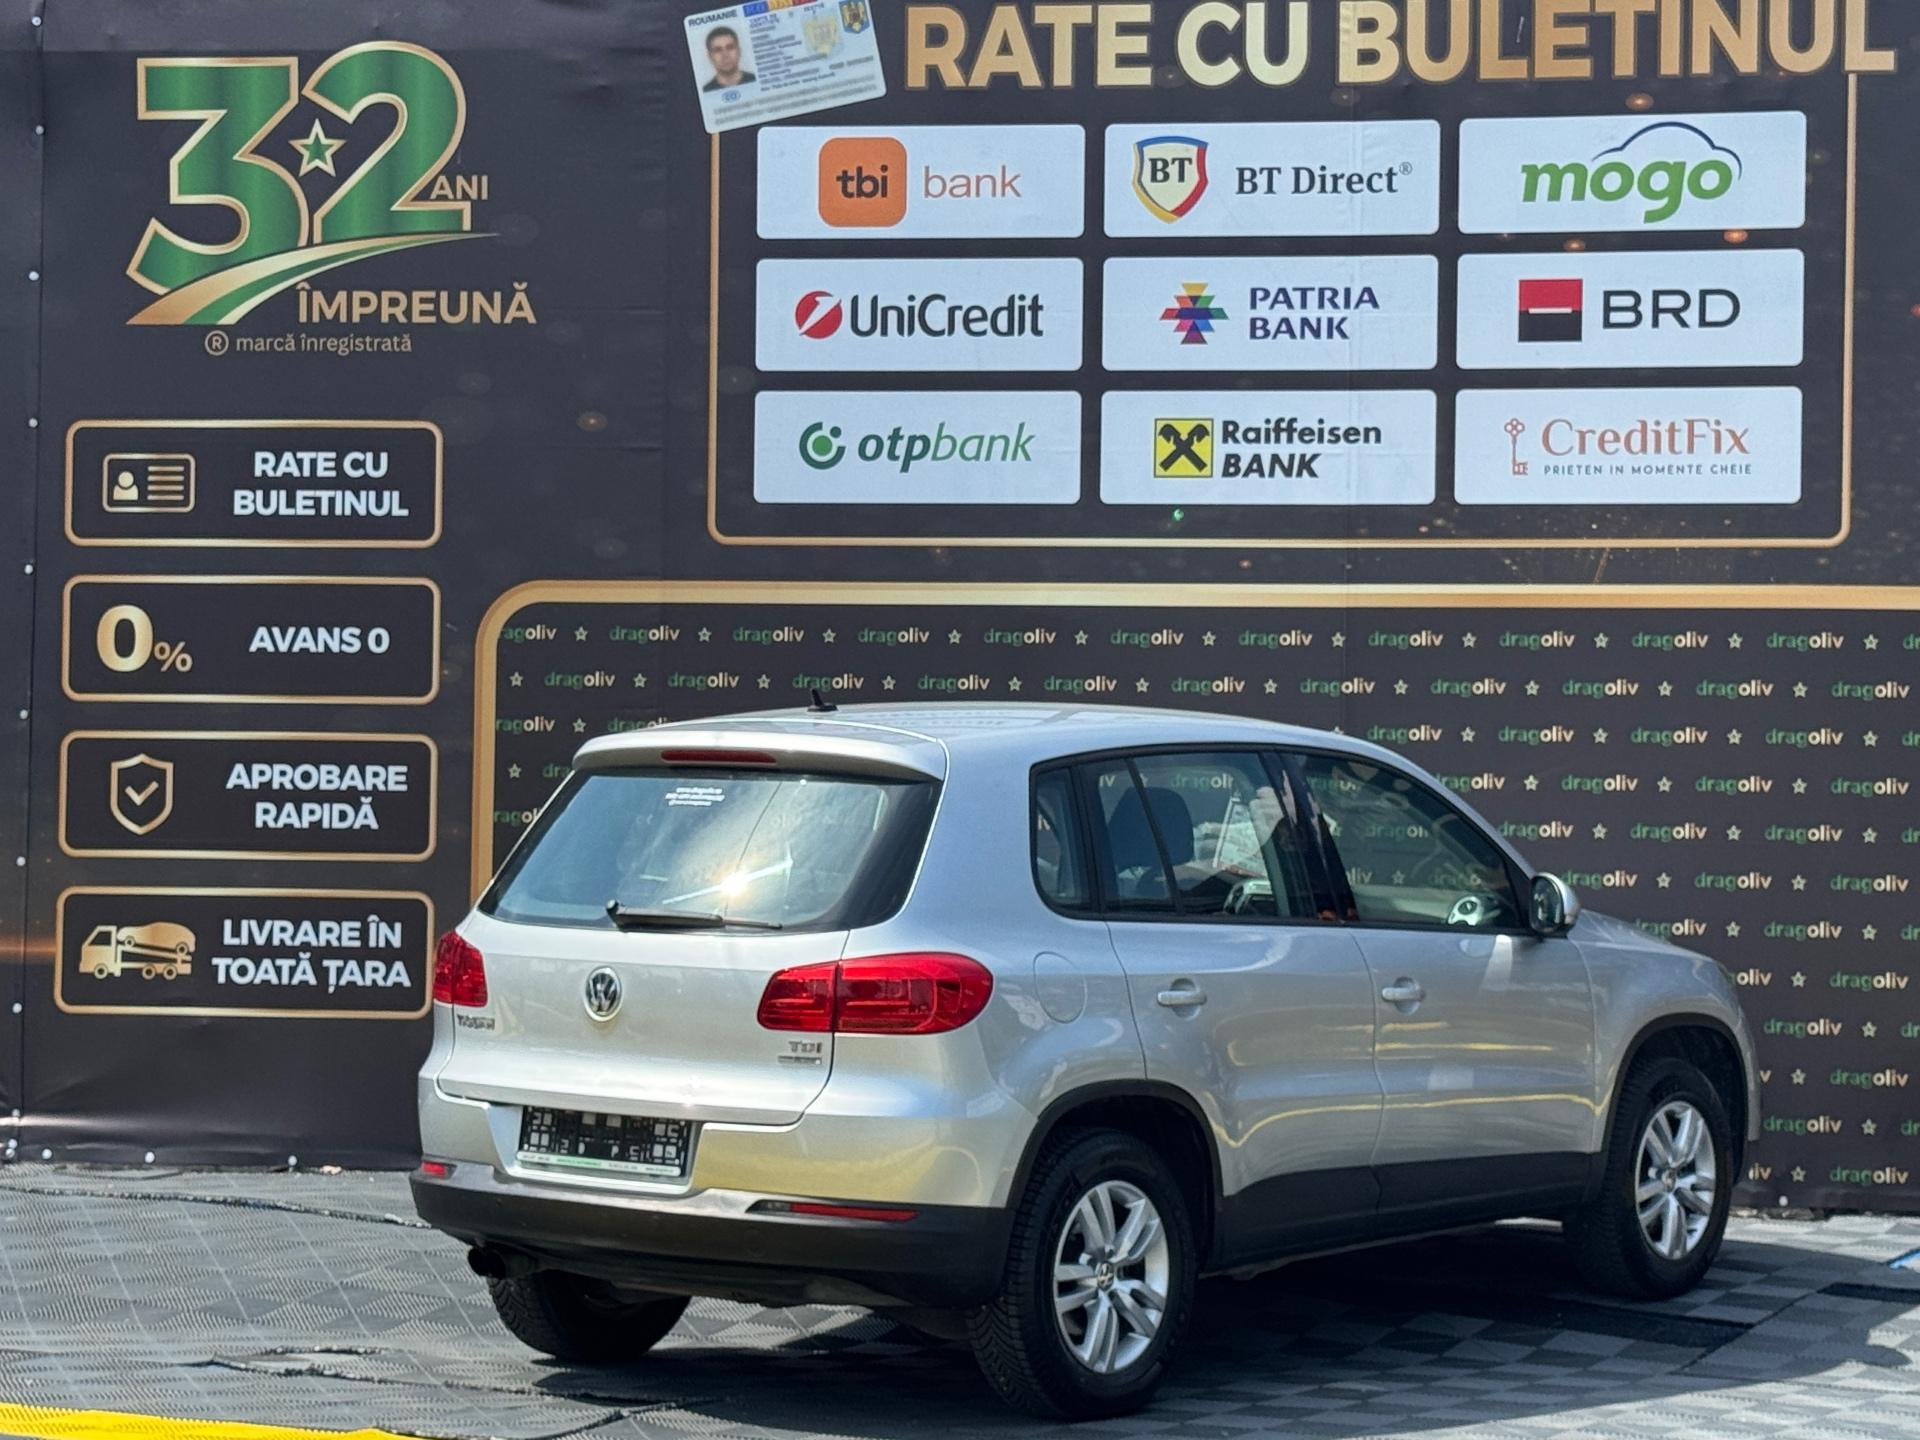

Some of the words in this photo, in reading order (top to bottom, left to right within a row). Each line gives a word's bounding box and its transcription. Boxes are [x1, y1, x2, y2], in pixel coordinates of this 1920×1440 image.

[907, 4, 1152, 87] RATE
[1176, 2, 1309, 86] CU
[1337, 0, 1897, 83] BULETINUL
[126, 40, 471, 295] 32
[1149, 157, 1193, 184] BT
[430, 174, 489, 200] ANI
[836, 165, 888, 198] tbi
[924, 165, 1021, 198] bank
[1236, 167, 1281, 194] BT
[1520, 158, 1733, 224] mogo
[296, 282, 537, 325] ÎMPREUNĂ
[1250, 287, 1379, 310] PATRIA
[851, 294, 1043, 337] UniCredit
[1603, 289, 1740, 329] BRD
[1250, 317, 1349, 340] BANK
[237, 334, 295, 351] marcă
[300, 333, 411, 356] înregistrată
[1222, 417, 1381, 444] Raiffeisen
[1542, 419, 1749, 456] CreditFix
[858, 422, 1034, 473] otpbank
[255, 452, 336, 477] RATE
[343, 452, 388, 478] CU
[1222, 453, 1321, 478] BANK
[1544, 465, 1602, 475] PRIETEN
[1610, 465, 1624, 475] IN
[1632, 464, 1702, 475] MOMENTE
[1710, 464, 1751, 474] CHEIE
[234, 490, 409, 516] BULETINUL
[249, 627, 361, 653] AVANS
[368, 628, 389, 653] 0
[503, 624, 557, 643] agoliv
[610, 625, 680, 643] dragoliv
[734, 626, 804, 644] dragoliv
[859, 627, 929, 645] dragoliv
[985, 628, 1056, 644] dragoliv
[1112, 629, 1184, 647] dragoliv
[1240, 630, 1312, 648] dragoliv
[1369, 630, 1443, 648] dragoliv
[1500, 631, 1575, 649] dragoliv
[1633, 631, 1708, 650] dragoliv
[1767, 632, 1844, 651] dragoliv
[546, 671, 615, 689] dragoliv
[669, 672, 739, 689] dragoliv
[792, 673, 864, 692] dragoliv
[919, 674, 990, 690] dragoliv
[1046, 676, 1117, 693] dragoliv
[1173, 677, 1245, 694] dragoliv
[1301, 678, 1375, 696] dragoliv
[1431, 678, 1506, 697] dragoliv
[1563, 679, 1639, 697] dragoliv
[1697, 680, 1773, 698] dragoliv
[1833, 681, 1910, 700] dragoliv
[496, 716, 555, 733] ragoliv
[1367, 725, 1443, 744] dragoliv
[1499, 726, 1574, 744] dragoliv
[1632, 727, 1708, 745] dragoliv
[1766, 728, 1843, 747] dragoliv
[226, 763, 407, 791] APROBARE
[1562, 774, 1638, 793] dragoliv
[1696, 776, 1772, 794] dragoliv
[1832, 778, 1909, 796] dragoliv
[256, 797, 378, 829] RAPIDĂ
[1499, 820, 1574, 838] dragoliv
[1631, 822, 1707, 842] dragoliv
[1766, 825, 1842, 843] dragoliv
[1695, 872, 1772, 890] dragoliv
[1831, 875, 1908, 893] dragoliv
[224, 919, 361, 947] LIVRARE
[368, 915, 401, 948] ÎN
[1765, 921, 1842, 940] dragoliv
[212, 952, 317, 985] TOATĂ
[1831, 972, 1908, 991] dragoliv
[1765, 1018, 1842, 1037] dragoliv
[1831, 1069, 1908, 1086] dragoliv
[1765, 1116, 1841, 1134] dragoliv
[1830, 1167, 1908, 1184] dragoliv
